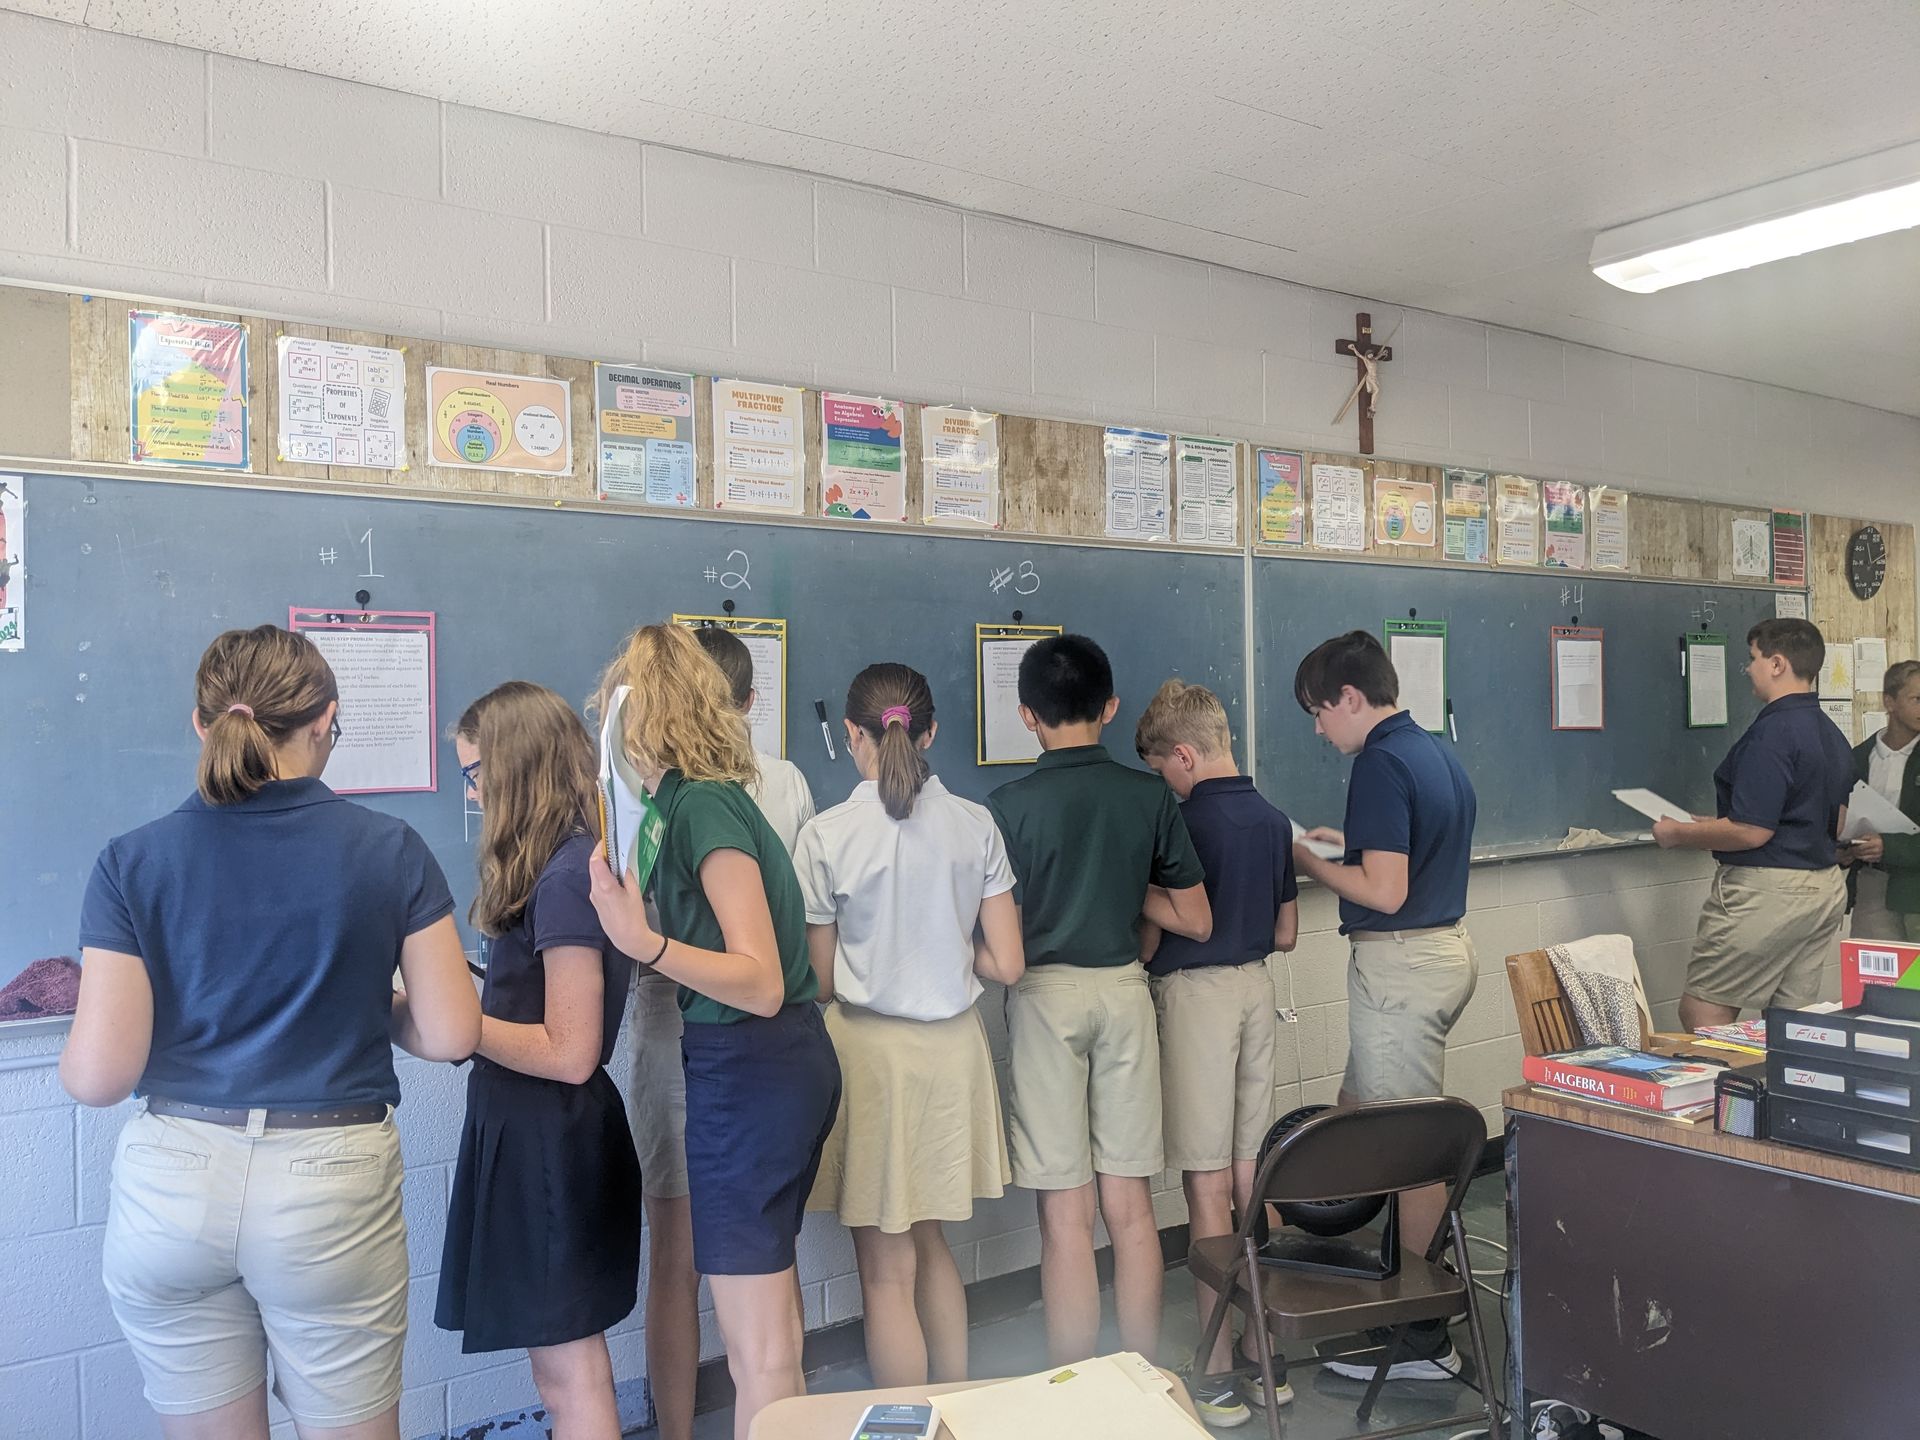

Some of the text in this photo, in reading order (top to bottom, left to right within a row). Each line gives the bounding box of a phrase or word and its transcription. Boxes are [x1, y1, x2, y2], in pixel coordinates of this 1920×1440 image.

[609, 374, 681, 390] DECIMAL OPERATIONS
[326, 388, 358, 398] PROPERTIES
[732, 391, 784, 404] MULTIPLYING
[737, 400, 782, 412] FRACTIONS
[834, 404, 856, 413] Anatomy
[328, 412, 357, 422] EXPONENTS
[943, 426, 979, 436] FRACTIONS
[704, 549, 752, 591] #2
[988, 560, 1040, 595] #3
[1560, 584, 1584, 614] #4
[1795, 1028, 1827, 1041] FILE
[1553, 1072, 1605, 1094] ALGEBRA
[1608, 1084, 1615, 1096] 1
[1793, 1072, 1817, 1084] IN
